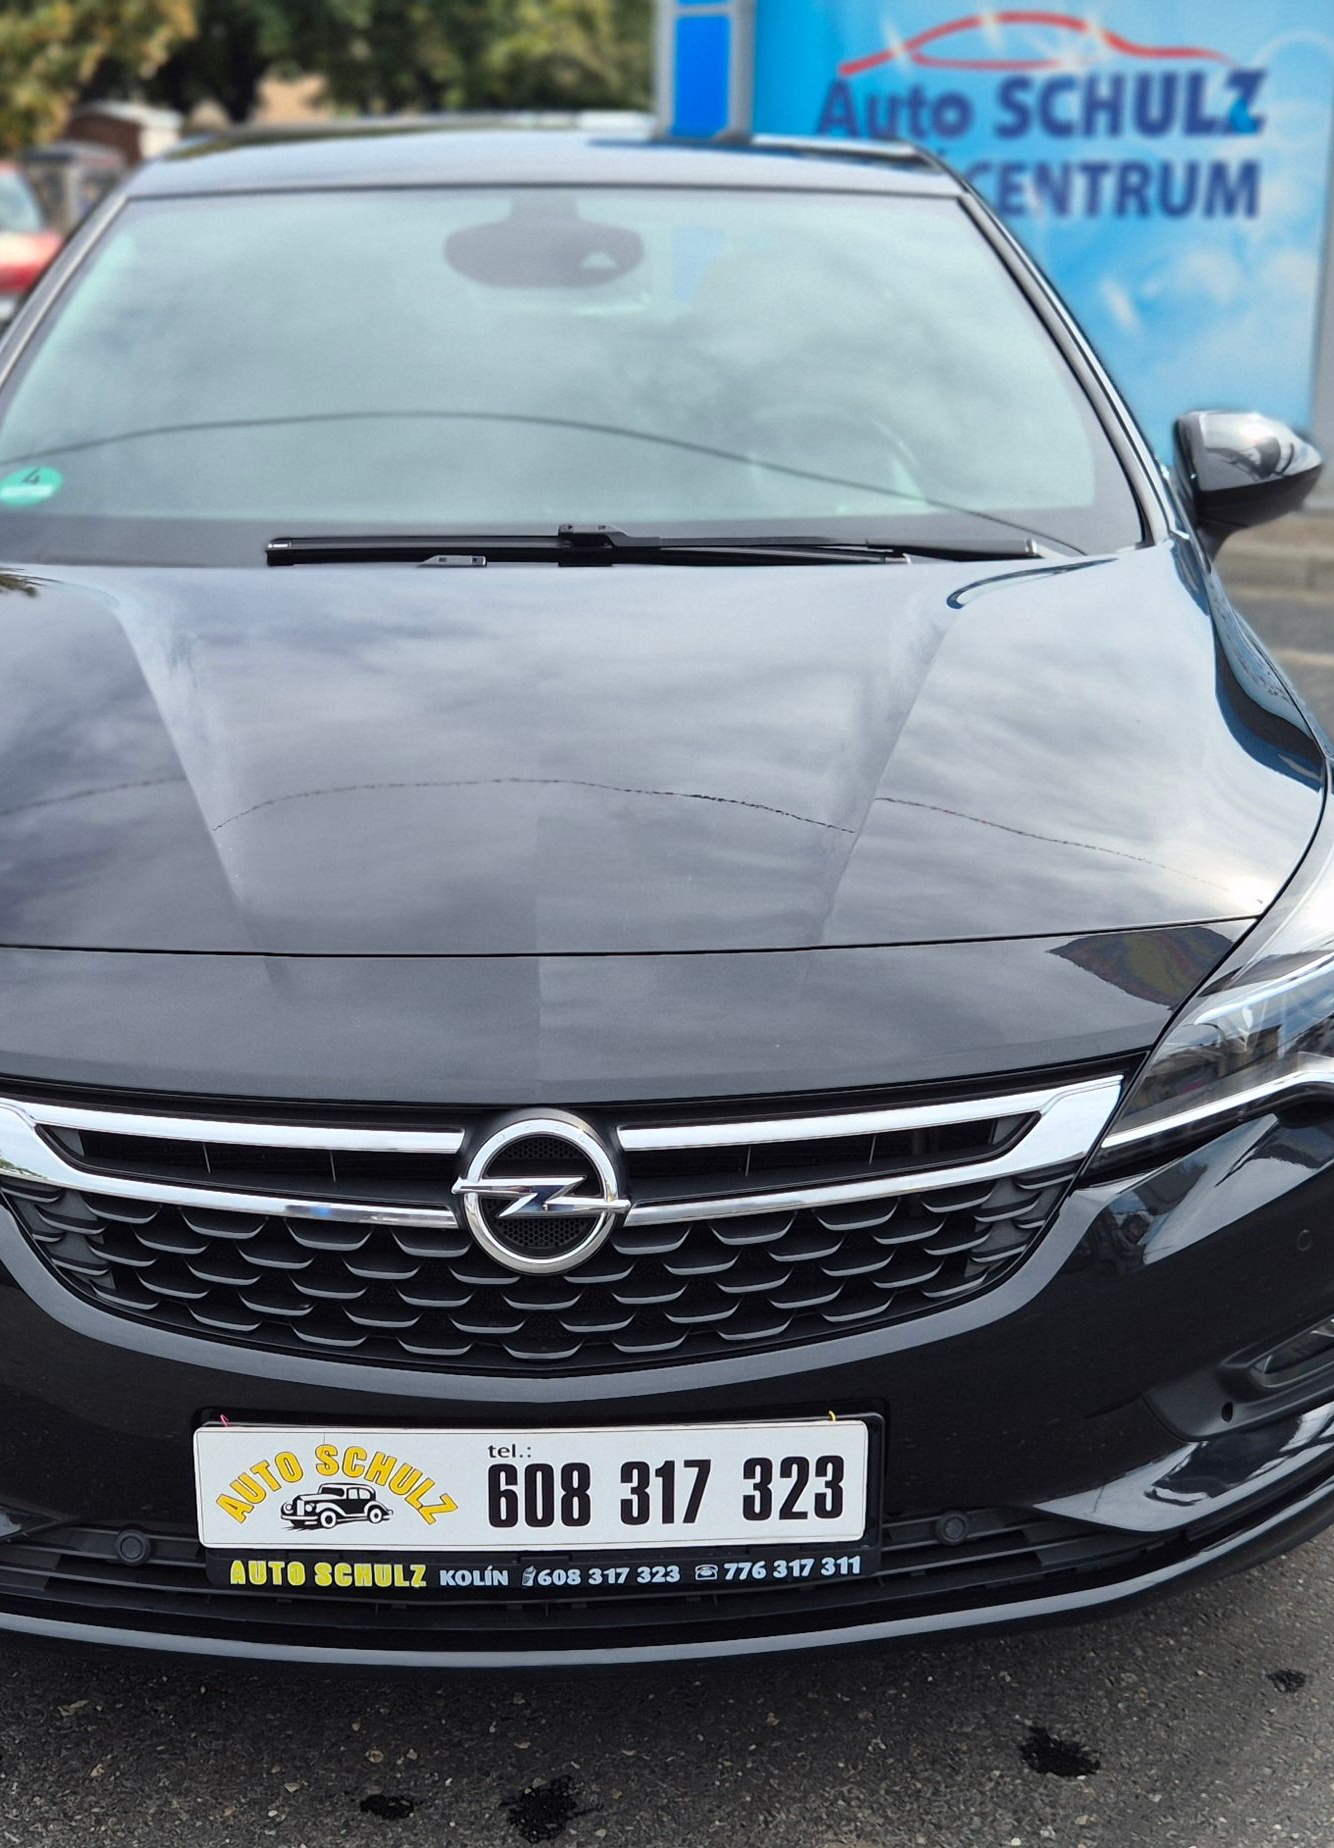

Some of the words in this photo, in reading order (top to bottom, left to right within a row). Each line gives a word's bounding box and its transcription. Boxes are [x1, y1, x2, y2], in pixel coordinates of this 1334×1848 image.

[816, 78, 975, 138] Auto
[995, 69, 1268, 138] SCHULZ
[215, 1450, 304, 1525] AUTO
[314, 1444, 459, 1526] SCHULZ
[488, 1443, 532, 1459] tel.:
[487, 1462, 592, 1529] 608
[619, 1458, 712, 1526] 317
[742, 1455, 845, 1522] 323
[229, 1559, 306, 1586] AUTO
[313, 1562, 427, 1587] SCHULZ
[439, 1564, 510, 1587] KOLÍN
[537, 1568, 581, 1586] 608
[587, 1567, 631, 1585] 317
[636, 1565, 682, 1584] 323
[723, 1560, 767, 1581] 776
[772, 1558, 816, 1578] 317
[820, 1555, 862, 1577] 311
